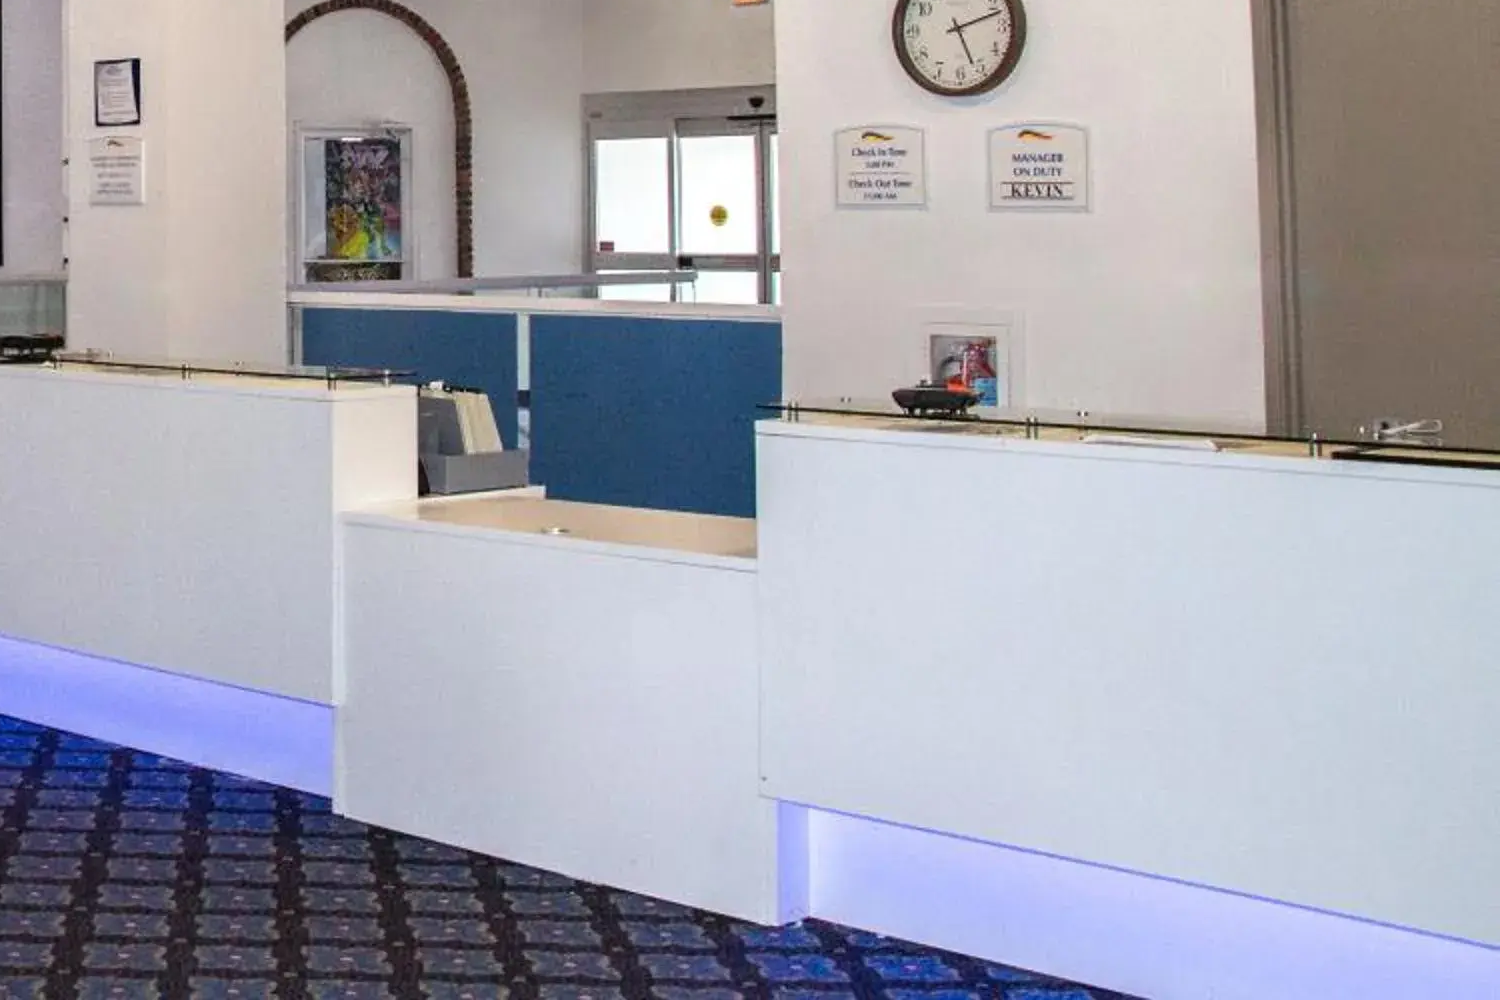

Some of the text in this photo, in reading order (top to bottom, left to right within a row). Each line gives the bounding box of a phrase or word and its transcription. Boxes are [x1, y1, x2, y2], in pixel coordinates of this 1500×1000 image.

[1011, 153, 1064, 162] MANAGER
[1013, 167, 1063, 177] ON DUTY
